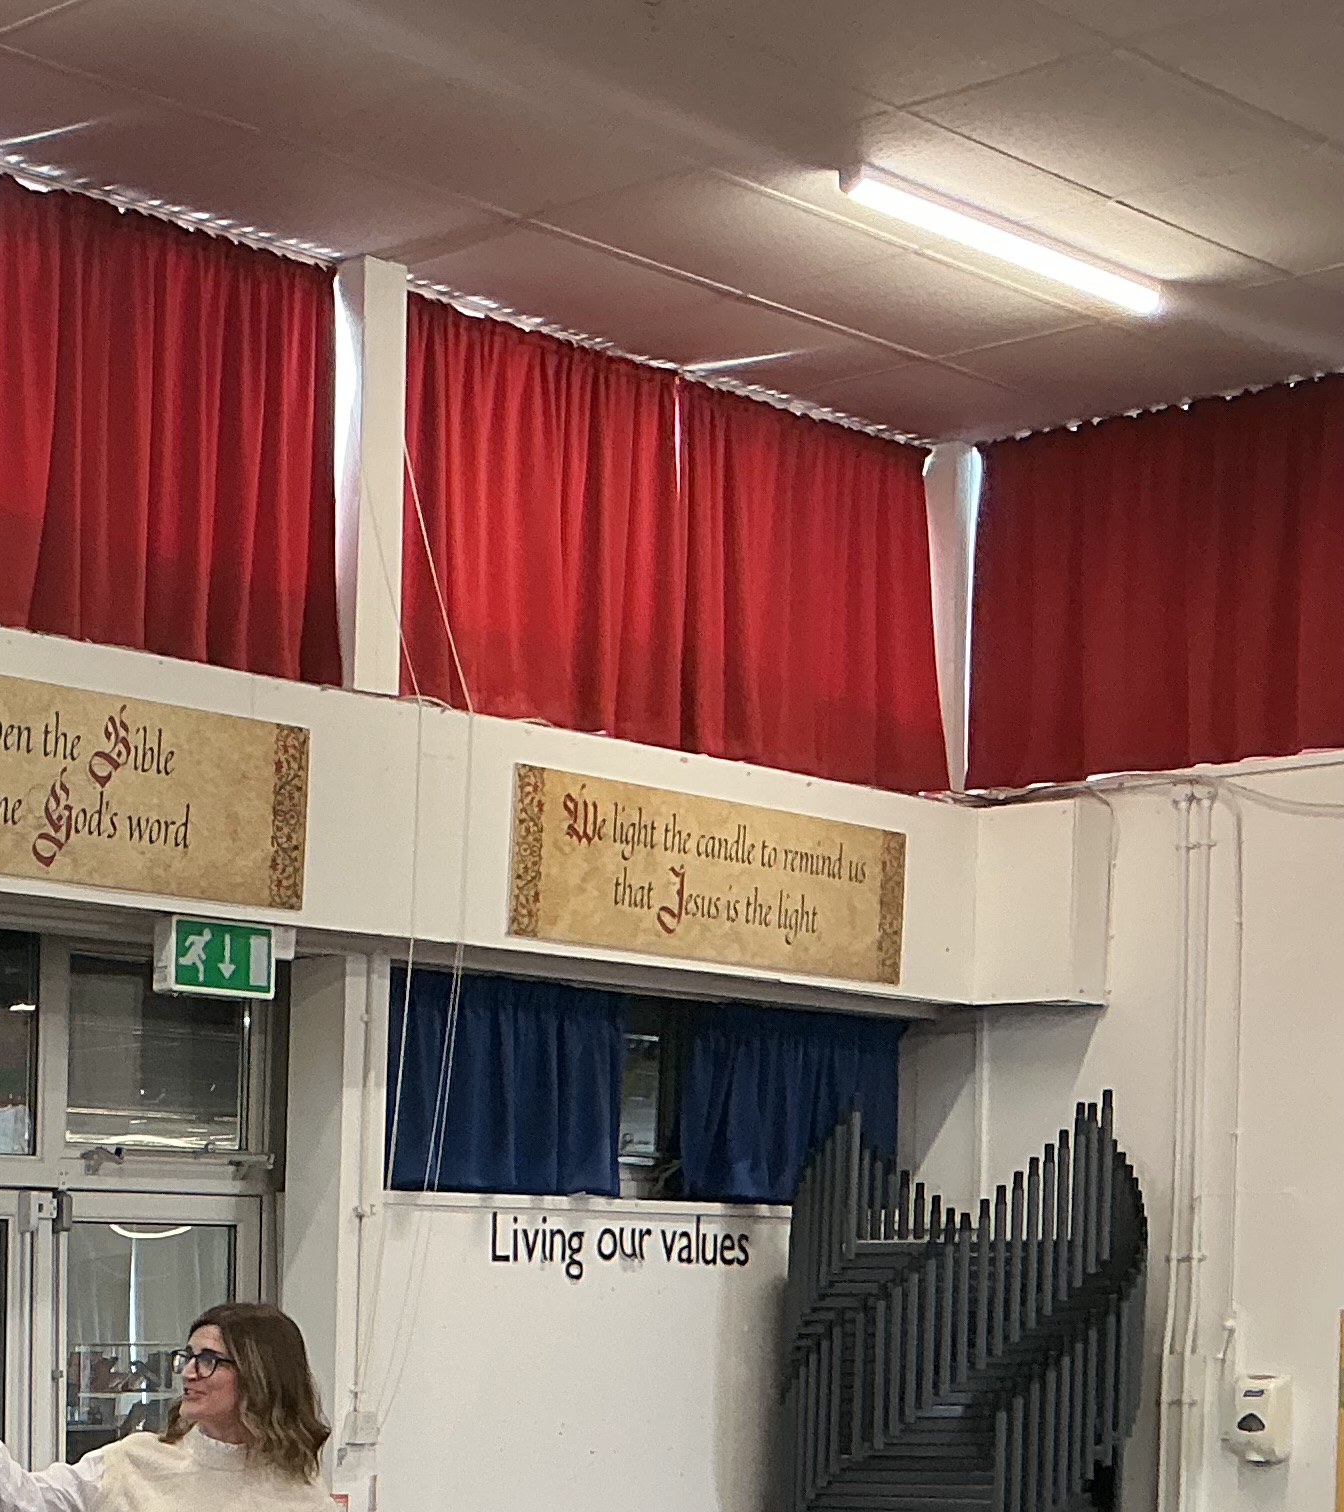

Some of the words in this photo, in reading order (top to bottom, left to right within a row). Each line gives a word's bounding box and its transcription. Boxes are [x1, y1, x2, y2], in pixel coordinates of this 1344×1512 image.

[42, 710, 82, 761] the
[88, 704, 176, 788] Bible
[32, 766, 118, 868] God's
[127, 803, 191, 851] word
[562, 783, 606, 845] We
[612, 801, 658, 861] light
[663, 812, 692, 855] the
[696, 823, 756, 866] candle
[760, 839, 778, 869] to
[783, 840, 844, 880] remind
[847, 857, 866, 884] us
[613, 866, 654, 911] that
[656, 864, 721, 935] Jesus
[725, 884, 739, 923] is
[744, 886, 772, 927] the
[777, 889, 818, 945] light
[491, 1210, 585, 1281] Living
[596, 1226, 652, 1262] our
[660, 1214, 750, 1267] values
